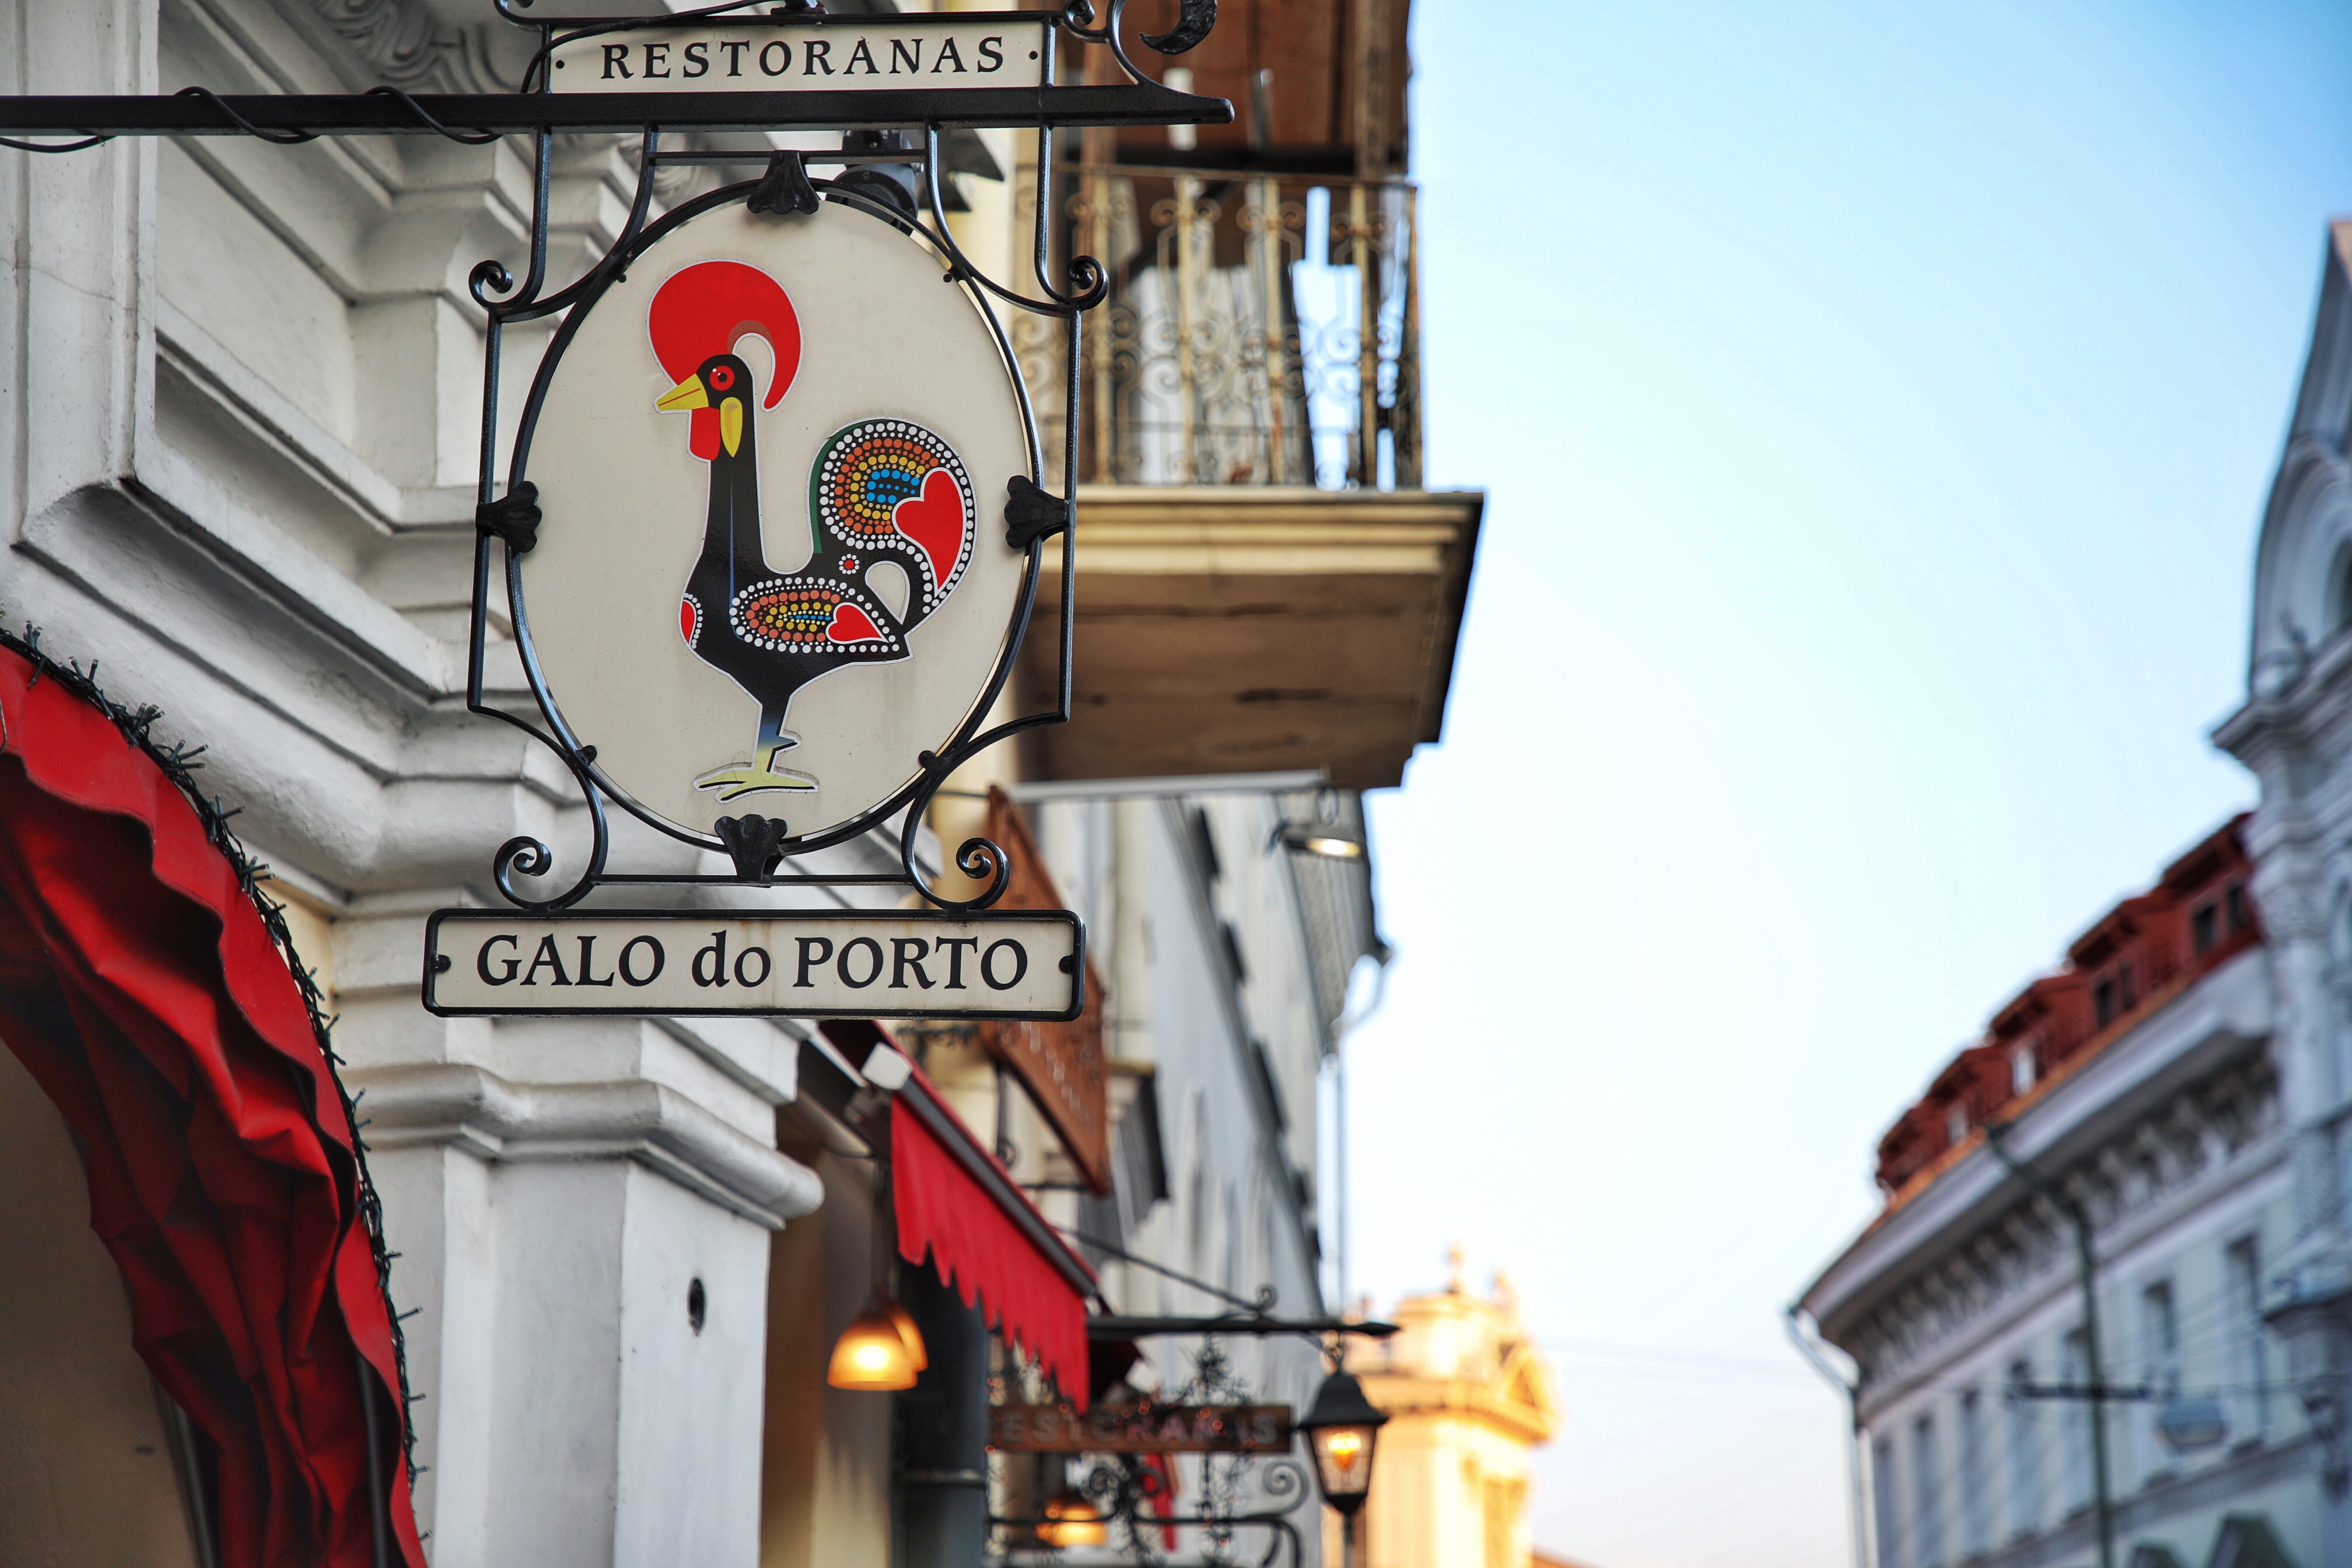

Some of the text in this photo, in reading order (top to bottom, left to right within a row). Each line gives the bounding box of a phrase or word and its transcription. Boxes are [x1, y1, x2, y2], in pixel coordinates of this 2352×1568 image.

[600, 36, 1004, 79] RESTORANAS
[476, 929, 1028, 991] GALO do PORTO
